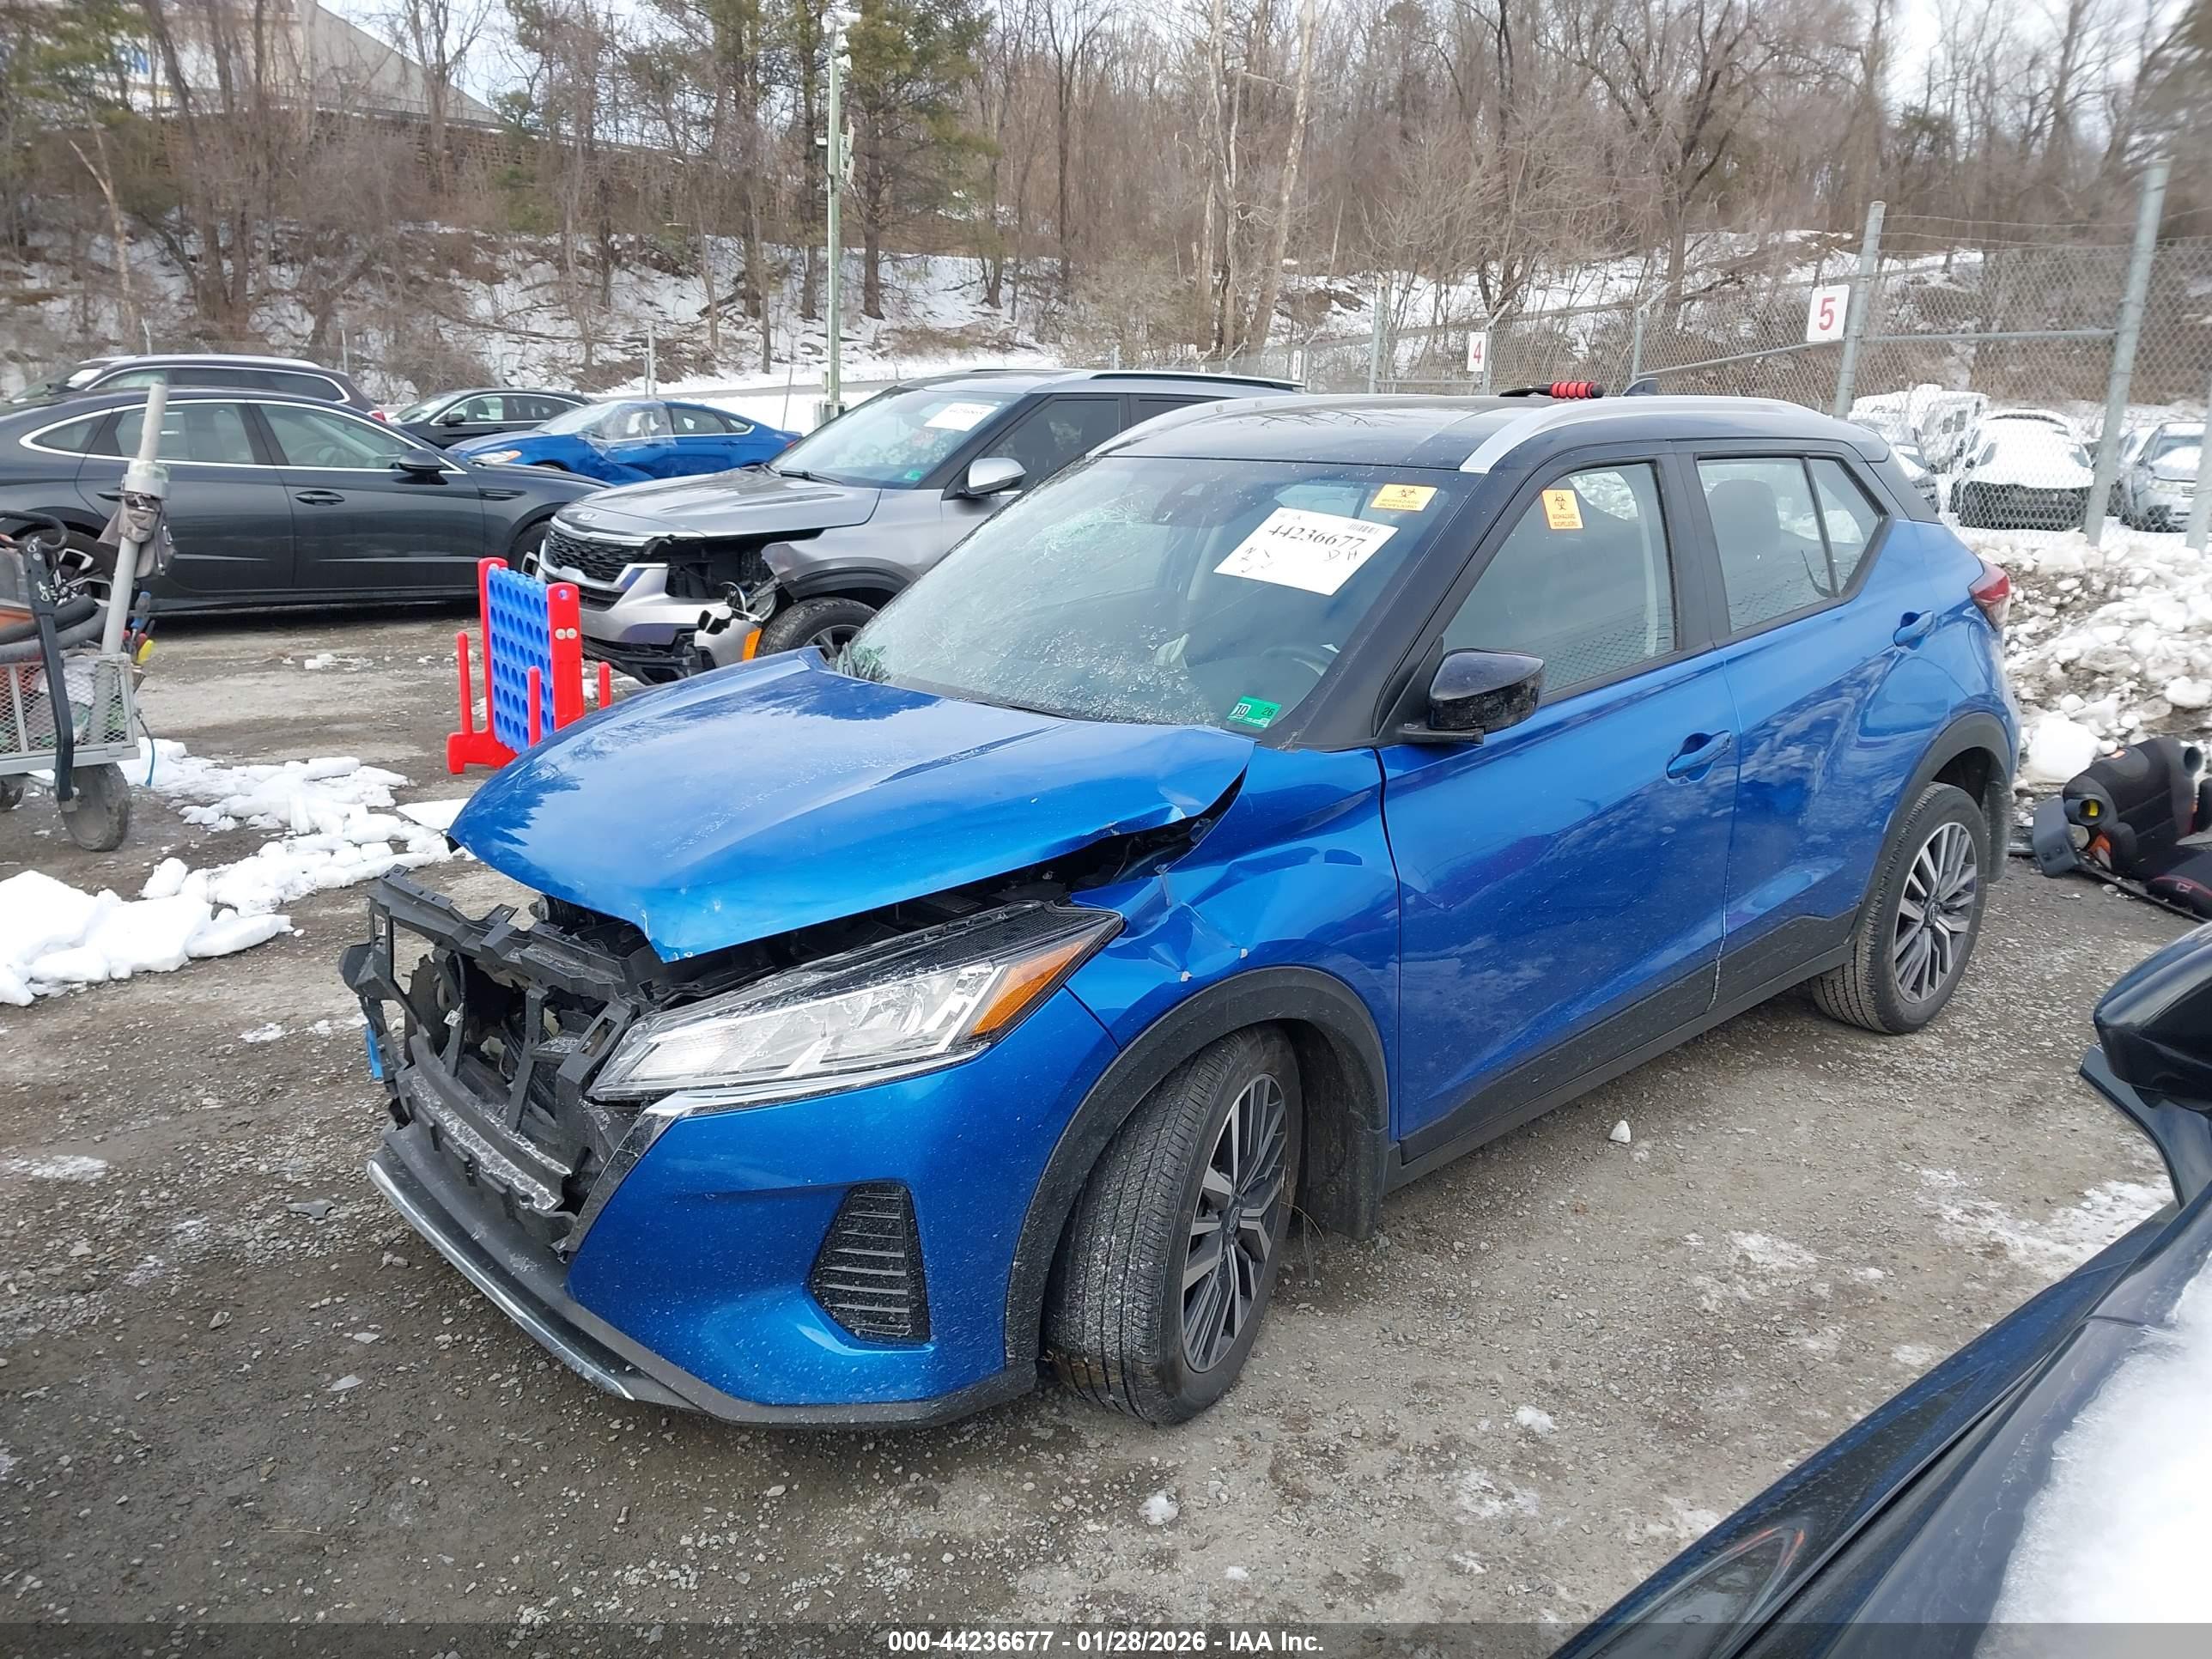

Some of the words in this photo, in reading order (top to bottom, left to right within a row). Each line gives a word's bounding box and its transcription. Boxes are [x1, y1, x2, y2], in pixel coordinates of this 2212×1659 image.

[1819, 296, 1836, 331] 5
[1474, 340, 1481, 364] 4
[1268, 524, 1367, 550] 44236677
[1233, 704, 1249, 716] 10
[1261, 707, 1275, 717] 26
